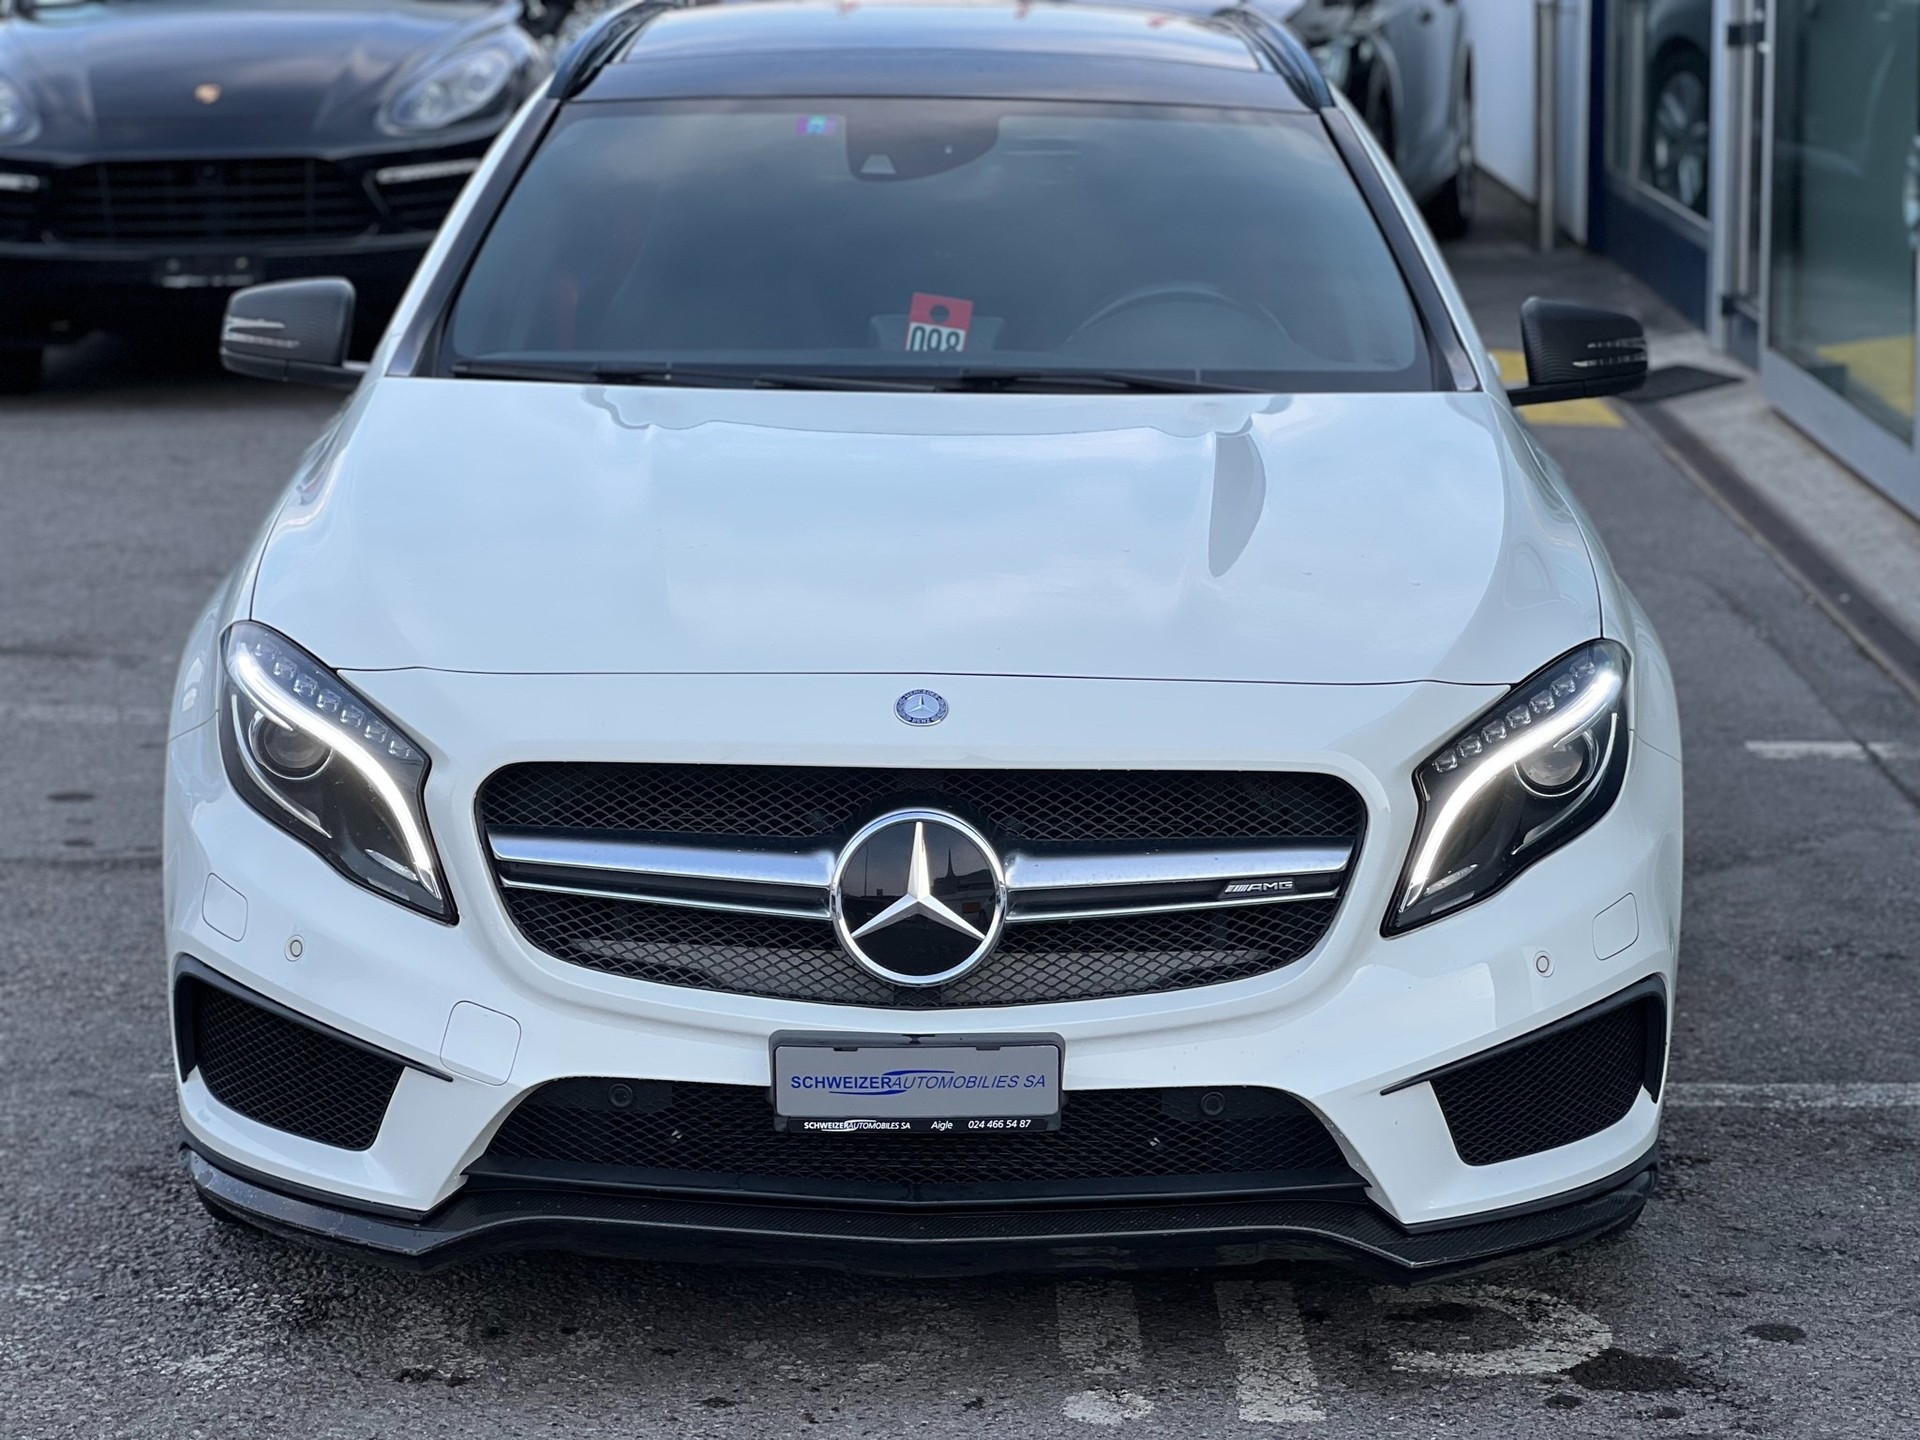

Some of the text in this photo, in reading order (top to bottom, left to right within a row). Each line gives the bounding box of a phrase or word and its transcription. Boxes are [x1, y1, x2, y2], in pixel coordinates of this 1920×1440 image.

[1023, 1074, 1046, 1088] SA
[900, 1121, 911, 1130] SA
[930, 1119, 954, 1131] Aigle
[967, 1119, 985, 1129] 024
[987, 1119, 1004, 1129] 466
[1006, 1119, 1018, 1129] 54
[1020, 1119, 1032, 1129] 87
